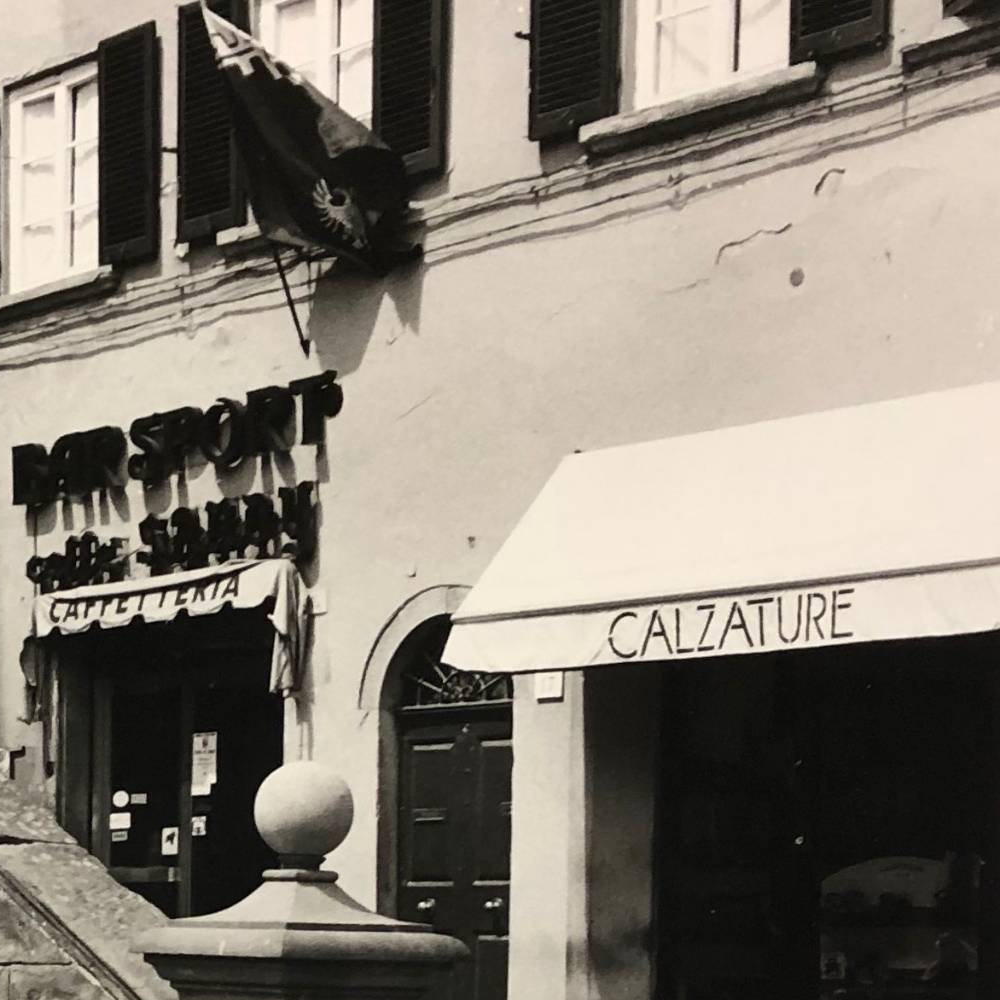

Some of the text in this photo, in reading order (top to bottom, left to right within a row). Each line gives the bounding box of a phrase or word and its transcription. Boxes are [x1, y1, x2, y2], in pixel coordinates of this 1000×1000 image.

[12, 370, 344, 505] BAR SPORT
[50, 575, 240, 624] CAFFETTERIA
[608, 588, 855, 659] CALZATURE
